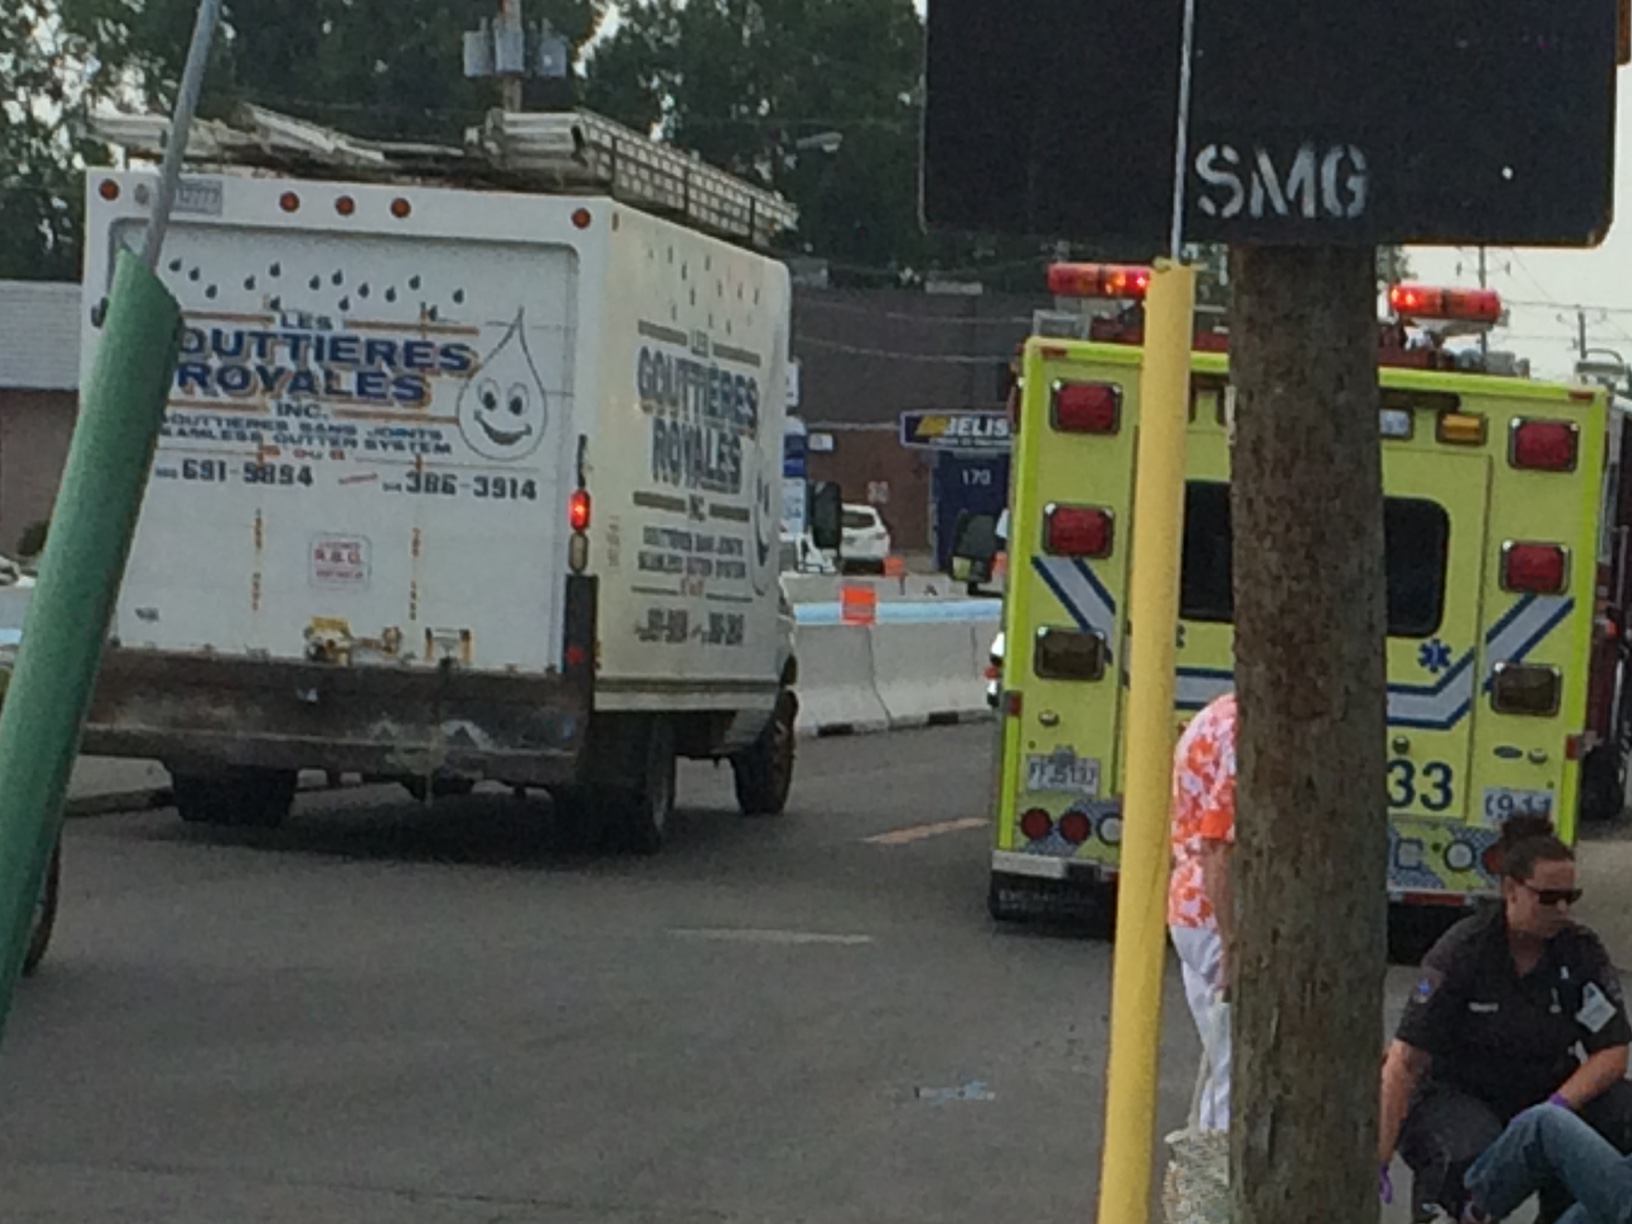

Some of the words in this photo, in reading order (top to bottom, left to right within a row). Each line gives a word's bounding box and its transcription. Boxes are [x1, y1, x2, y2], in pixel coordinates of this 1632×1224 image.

[1195, 144, 1367, 219] SMG
[280, 311, 333, 330] LES
[177, 361, 431, 405] ROYALES
[277, 403, 330, 420] INC.
[962, 469, 991, 485] 170
[1386, 759, 1453, 811] 33
